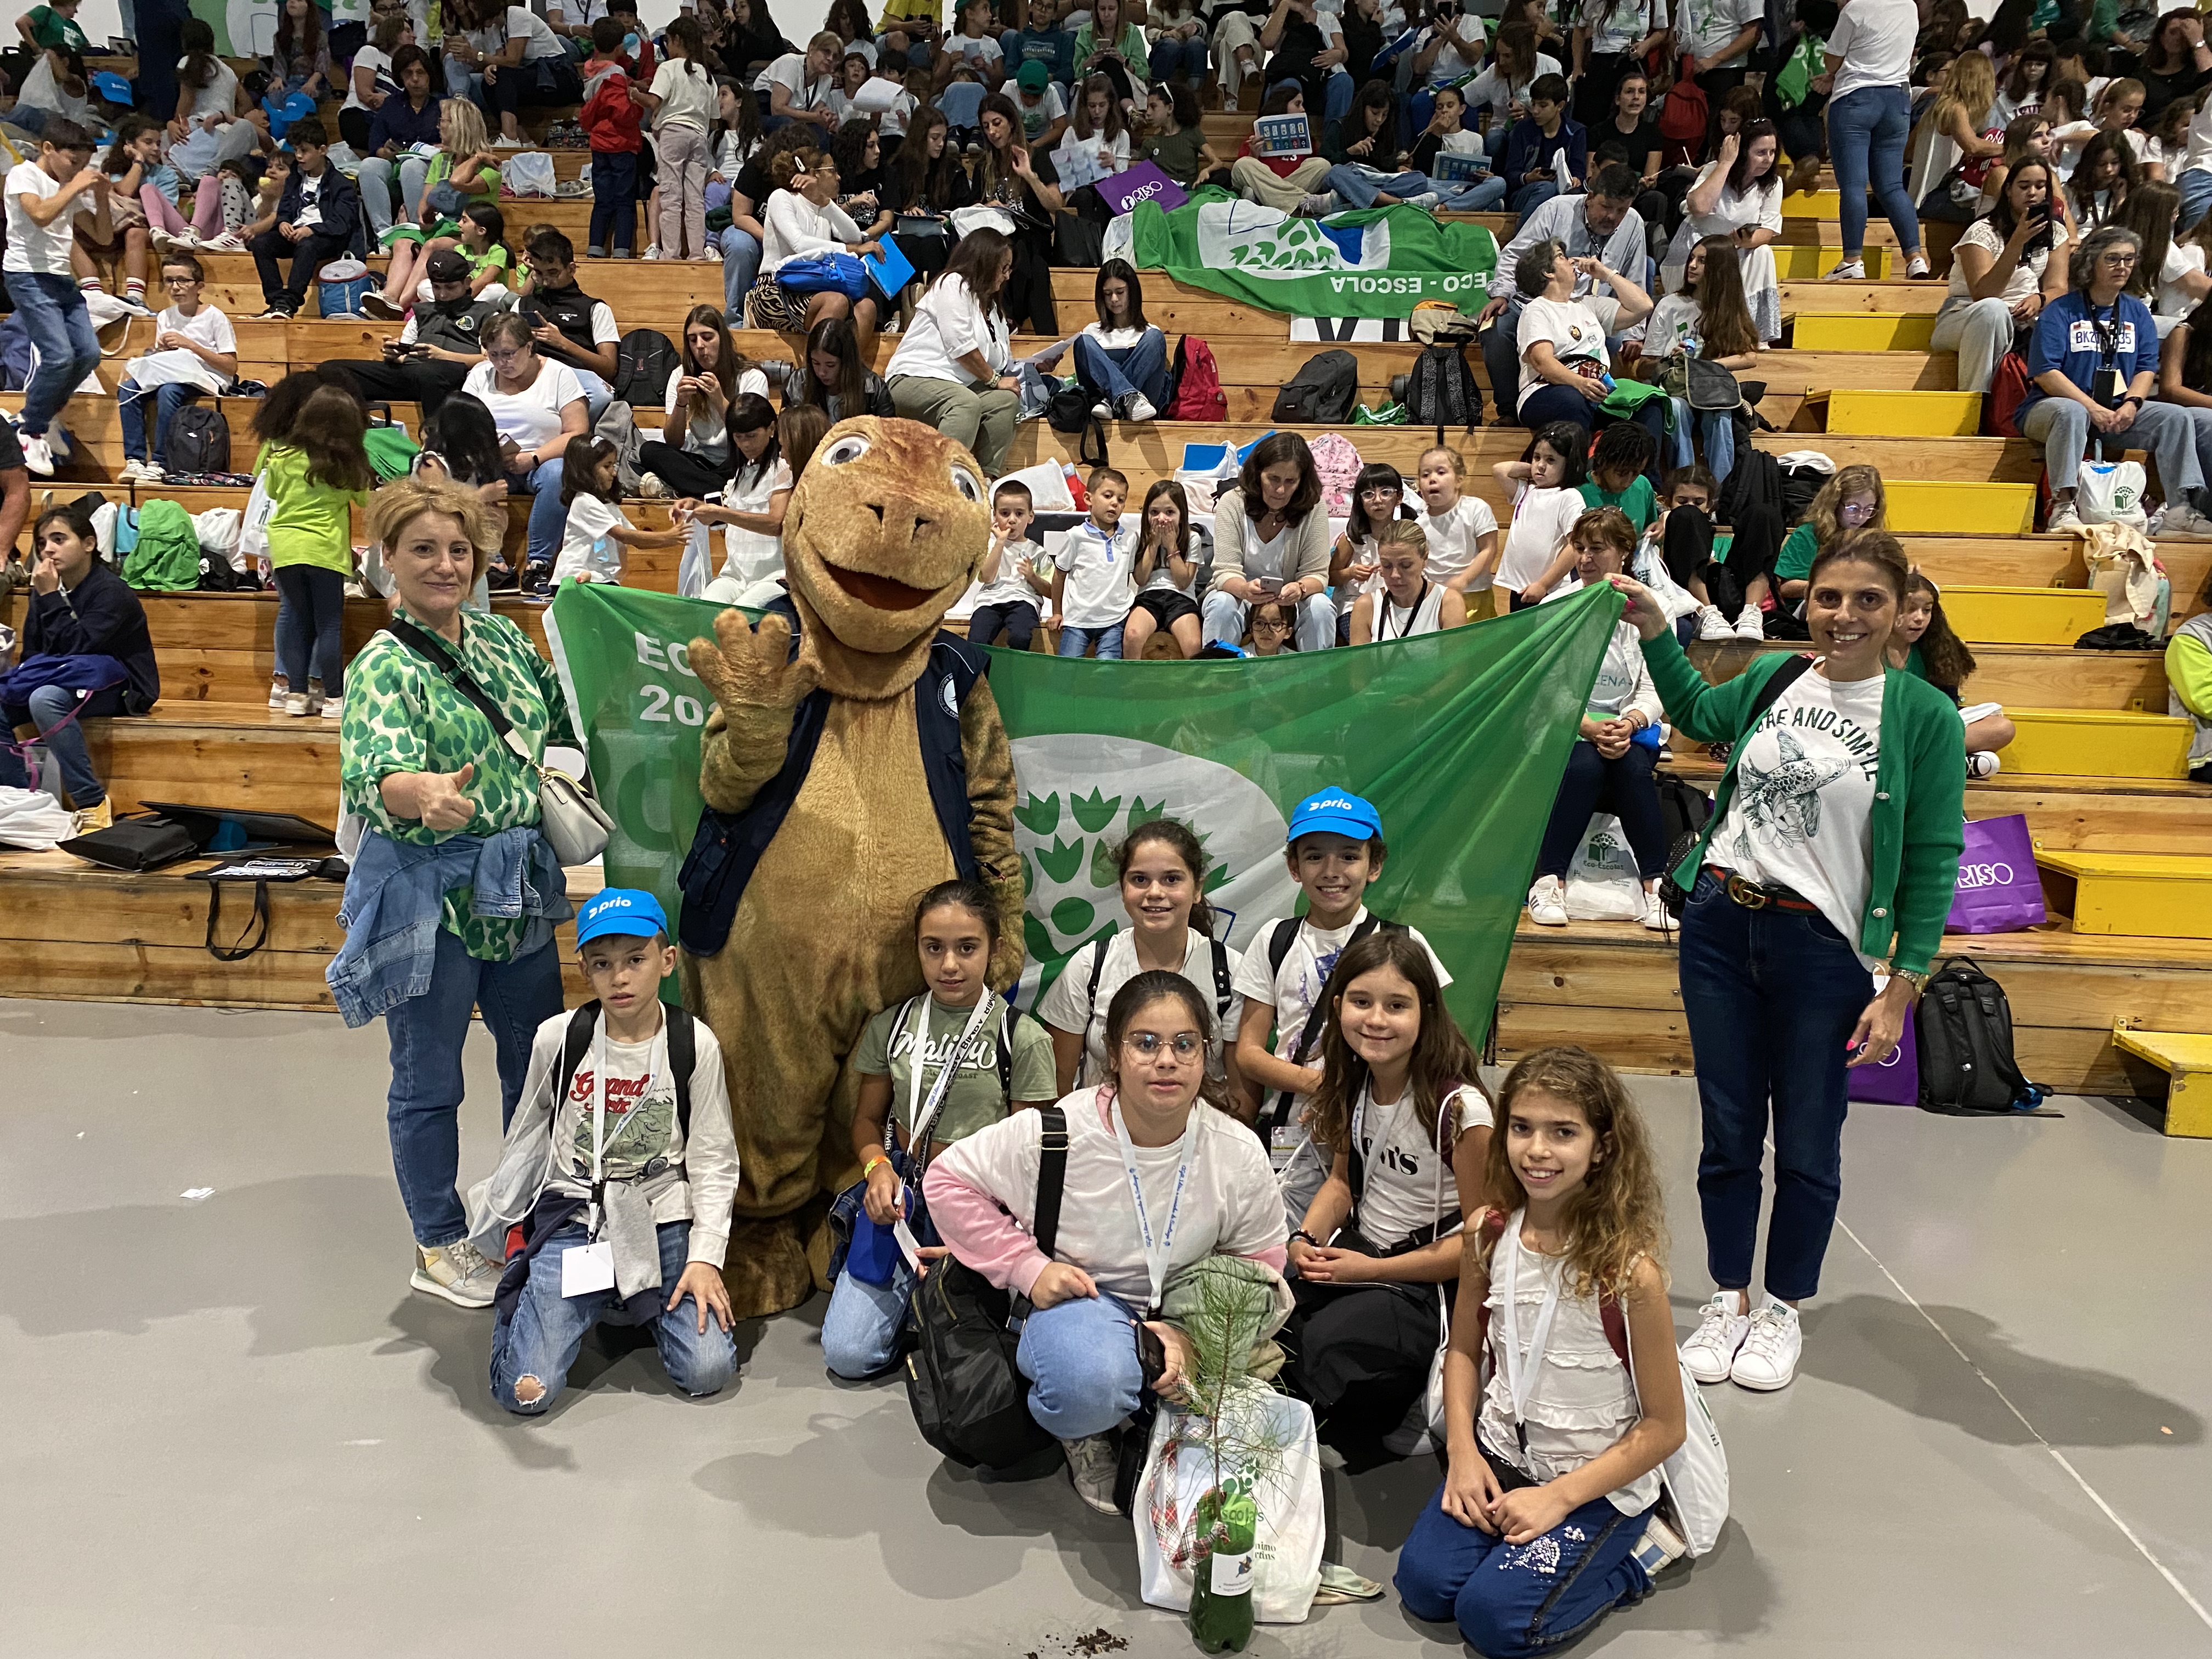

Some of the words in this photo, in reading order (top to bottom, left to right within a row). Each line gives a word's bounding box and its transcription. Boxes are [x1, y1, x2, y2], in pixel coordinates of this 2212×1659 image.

[1330, 277, 1422, 294] ESCOLA
[1443, 272, 1487, 292] ECO
[635, 631, 698, 676] EC
[640, 685, 721, 726] 20
[1792, 707, 1837, 731] AND
[1319, 798, 1352, 810] prio
[1583, 860, 1624, 870] Eco-Escolas
[1957, 862, 2013, 888] RISO
[599, 896, 631, 913] prio
[893, 1030, 997, 1069] Maliu
[569, 1071, 650, 1102] Gand
[1255, 1542, 1277, 1551] nimo
[1255, 1551, 1276, 1560] rtins
